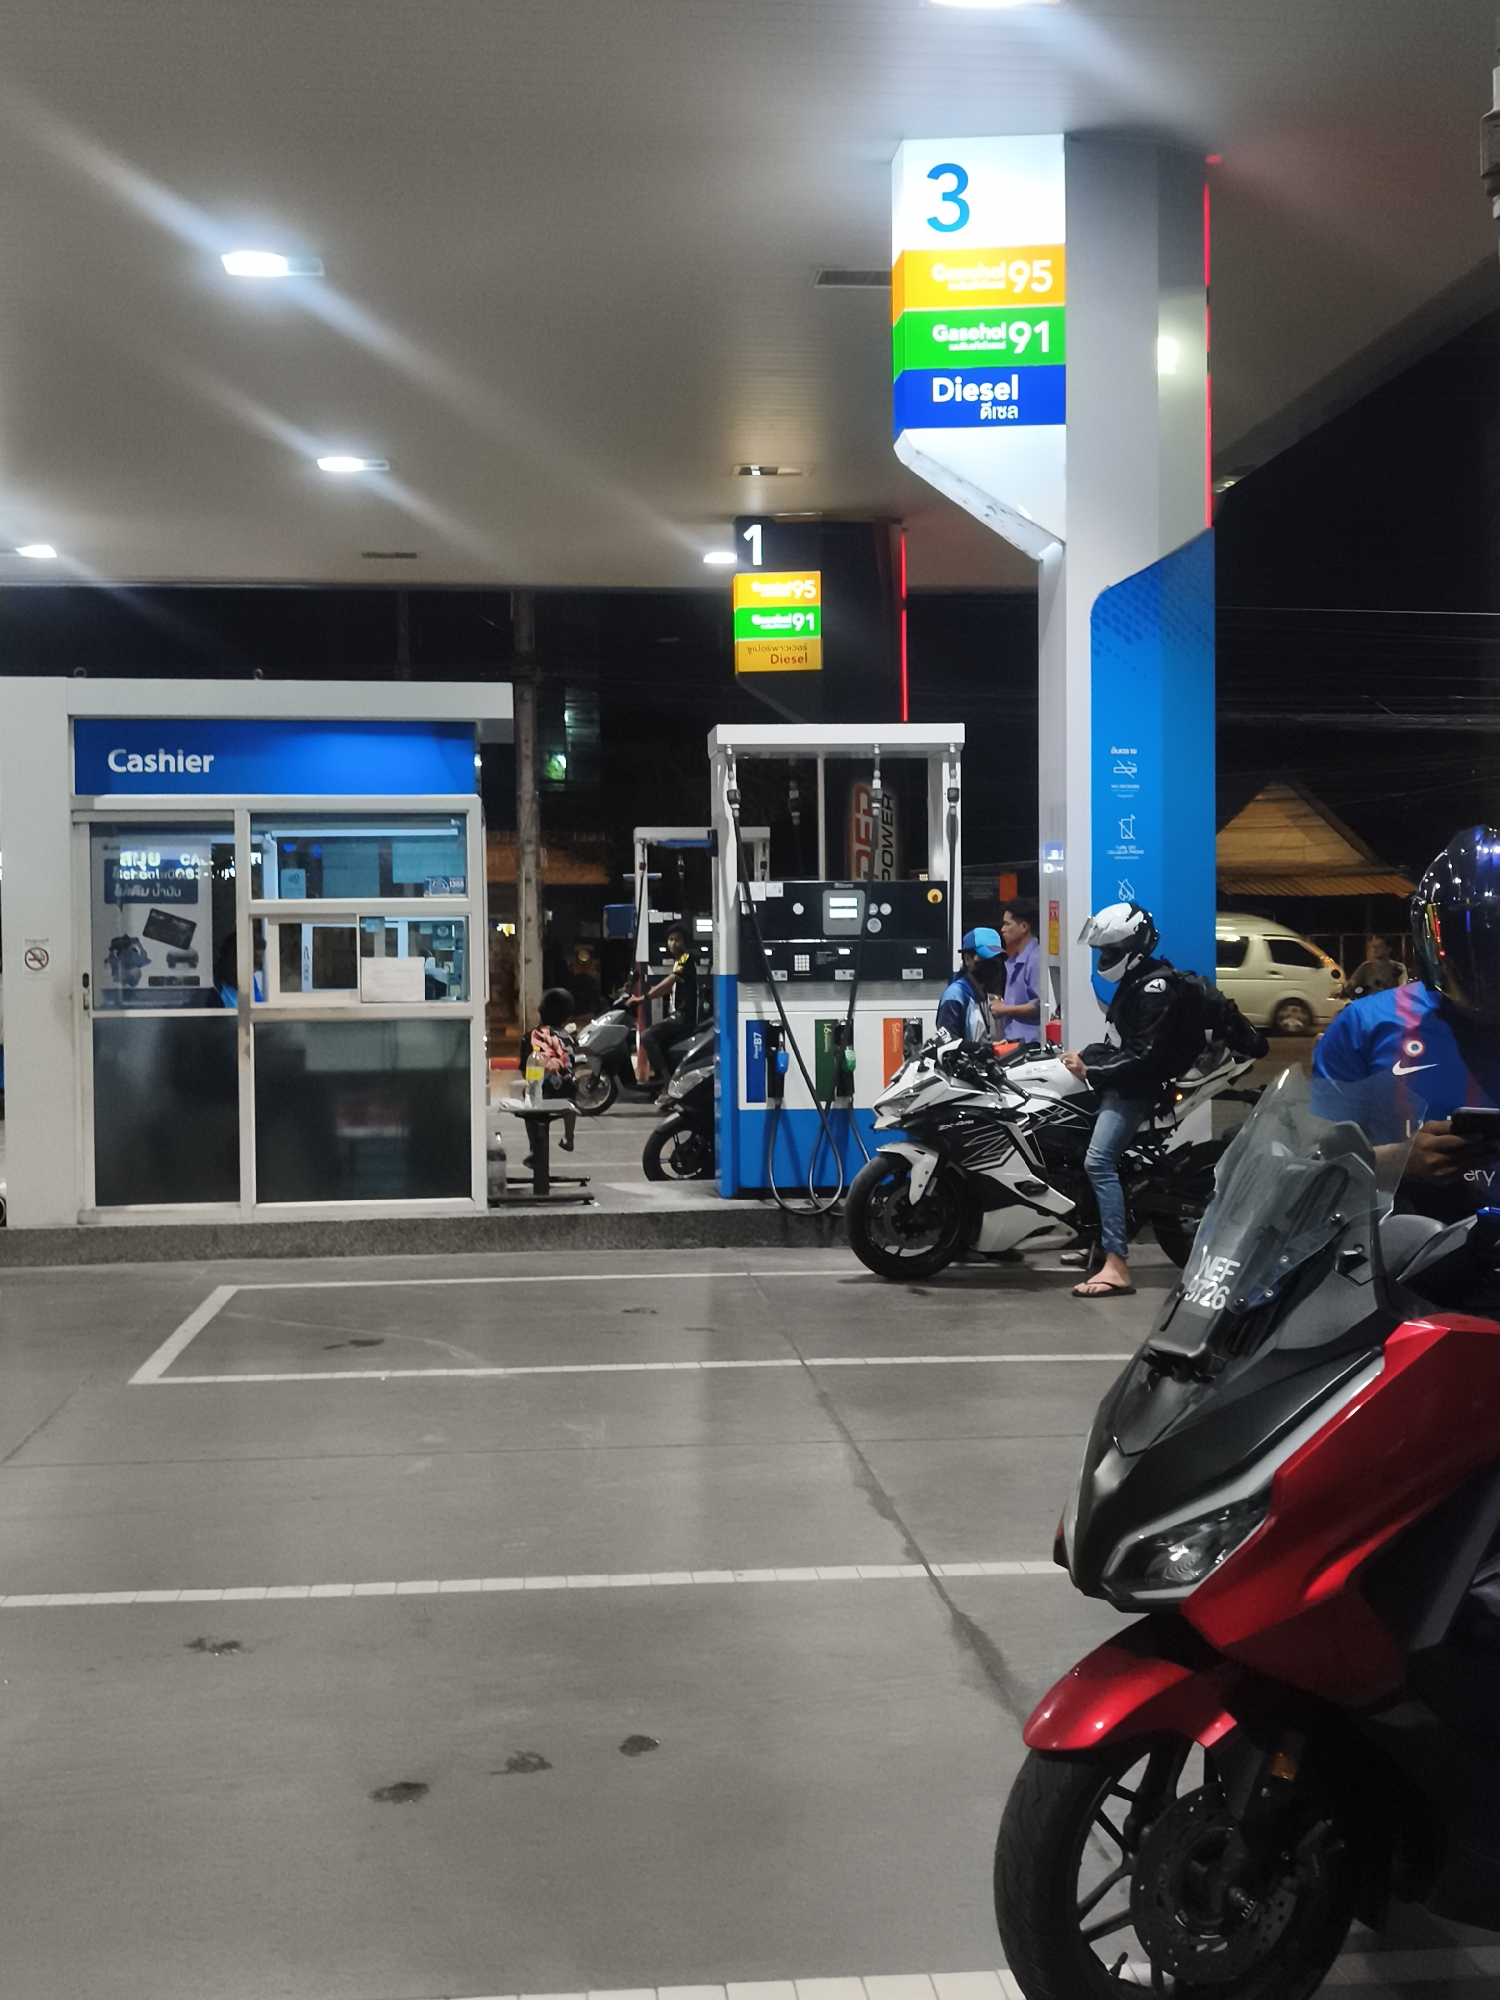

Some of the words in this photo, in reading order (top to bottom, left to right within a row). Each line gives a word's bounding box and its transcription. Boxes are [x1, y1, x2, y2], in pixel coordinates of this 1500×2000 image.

[926, 163, 970, 233] 3
[1008, 259, 1053, 294] 95
[932, 321, 1006, 342] Gasohol
[1008, 320, 1050, 354] 91
[932, 374, 1019, 402] Diesel
[980, 401, 1019, 420] ดีเซล
[743, 524, 762, 566] 1
[791, 579, 817, 599] 95
[792, 612, 815, 631] 91
[770, 652, 808, 665] Diesel
[107, 748, 214, 774] Cashier
[753, 1031, 763, 1045] B7
